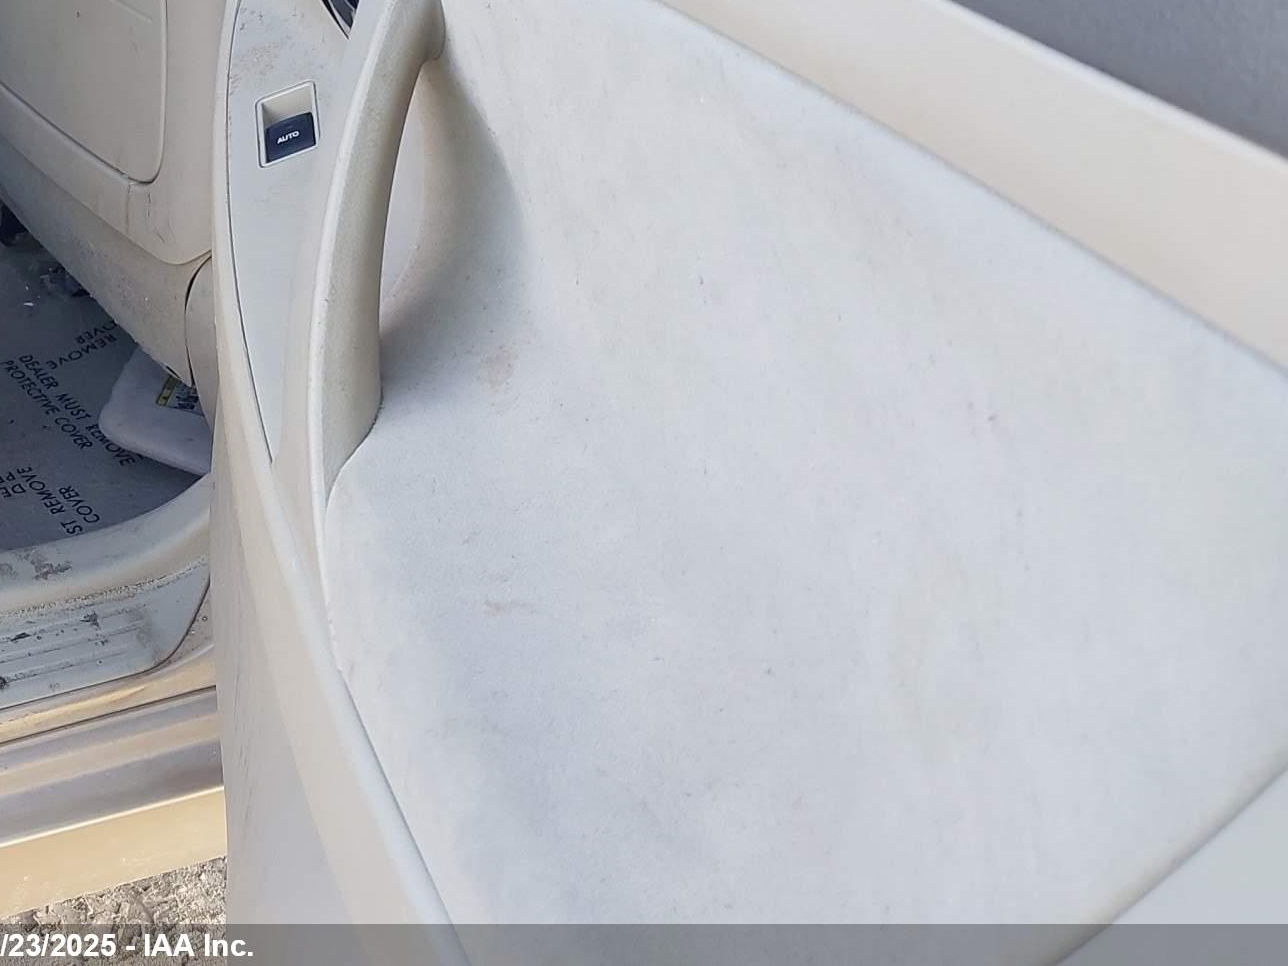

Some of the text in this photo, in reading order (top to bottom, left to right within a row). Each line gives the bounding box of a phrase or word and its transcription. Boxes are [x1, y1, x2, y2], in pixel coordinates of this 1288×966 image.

[277, 130, 300, 144] AUTO
[0, 360, 93, 450] PROTECTIVE COVER
[19, 354, 59, 390] DEALER
[56, 393, 92, 420] MUST
[17, 466, 65, 515] REMOVE
[59, 485, 100, 524] COVER
